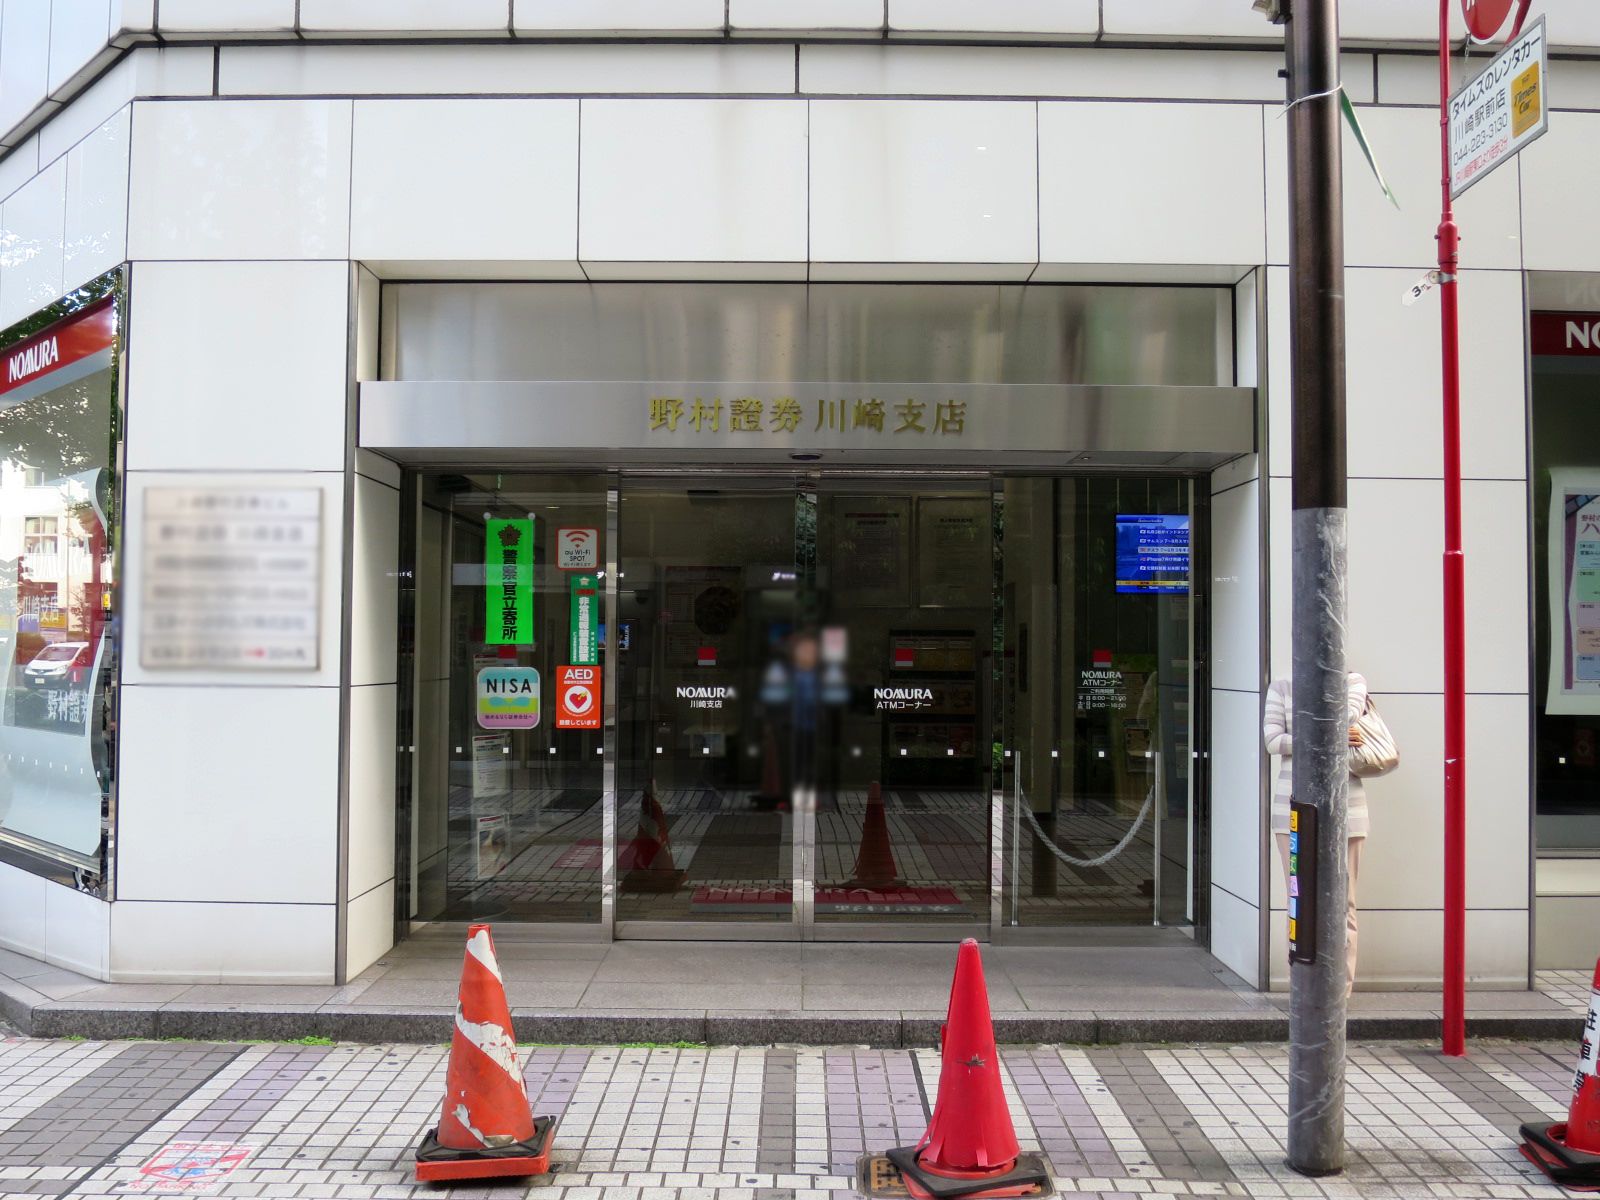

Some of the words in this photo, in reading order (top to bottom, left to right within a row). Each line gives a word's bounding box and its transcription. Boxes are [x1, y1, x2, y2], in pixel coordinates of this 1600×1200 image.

[1453, 36, 1541, 120] タイムズのレンタカー
[1514, 83, 1537, 106] Times
[1519, 100, 1532, 114] Car
[1454, 87, 1506, 144] 川崎駅前店
[1453, 112, 1508, 166] 044-223-3130
[9, 335, 59, 384] NOMURA
[502, 548, 518, 641] 警察官立寄所
[564, 668, 594, 680] AED
[1081, 671, 1122, 679] NOMURA
[486, 678, 532, 693] NISA
[676, 687, 735, 698] NOMURA
[874, 688, 933, 700] NOMURA
[690, 700, 722, 709] 川崎支店
[876, 702, 931, 710] ATMコーナー
